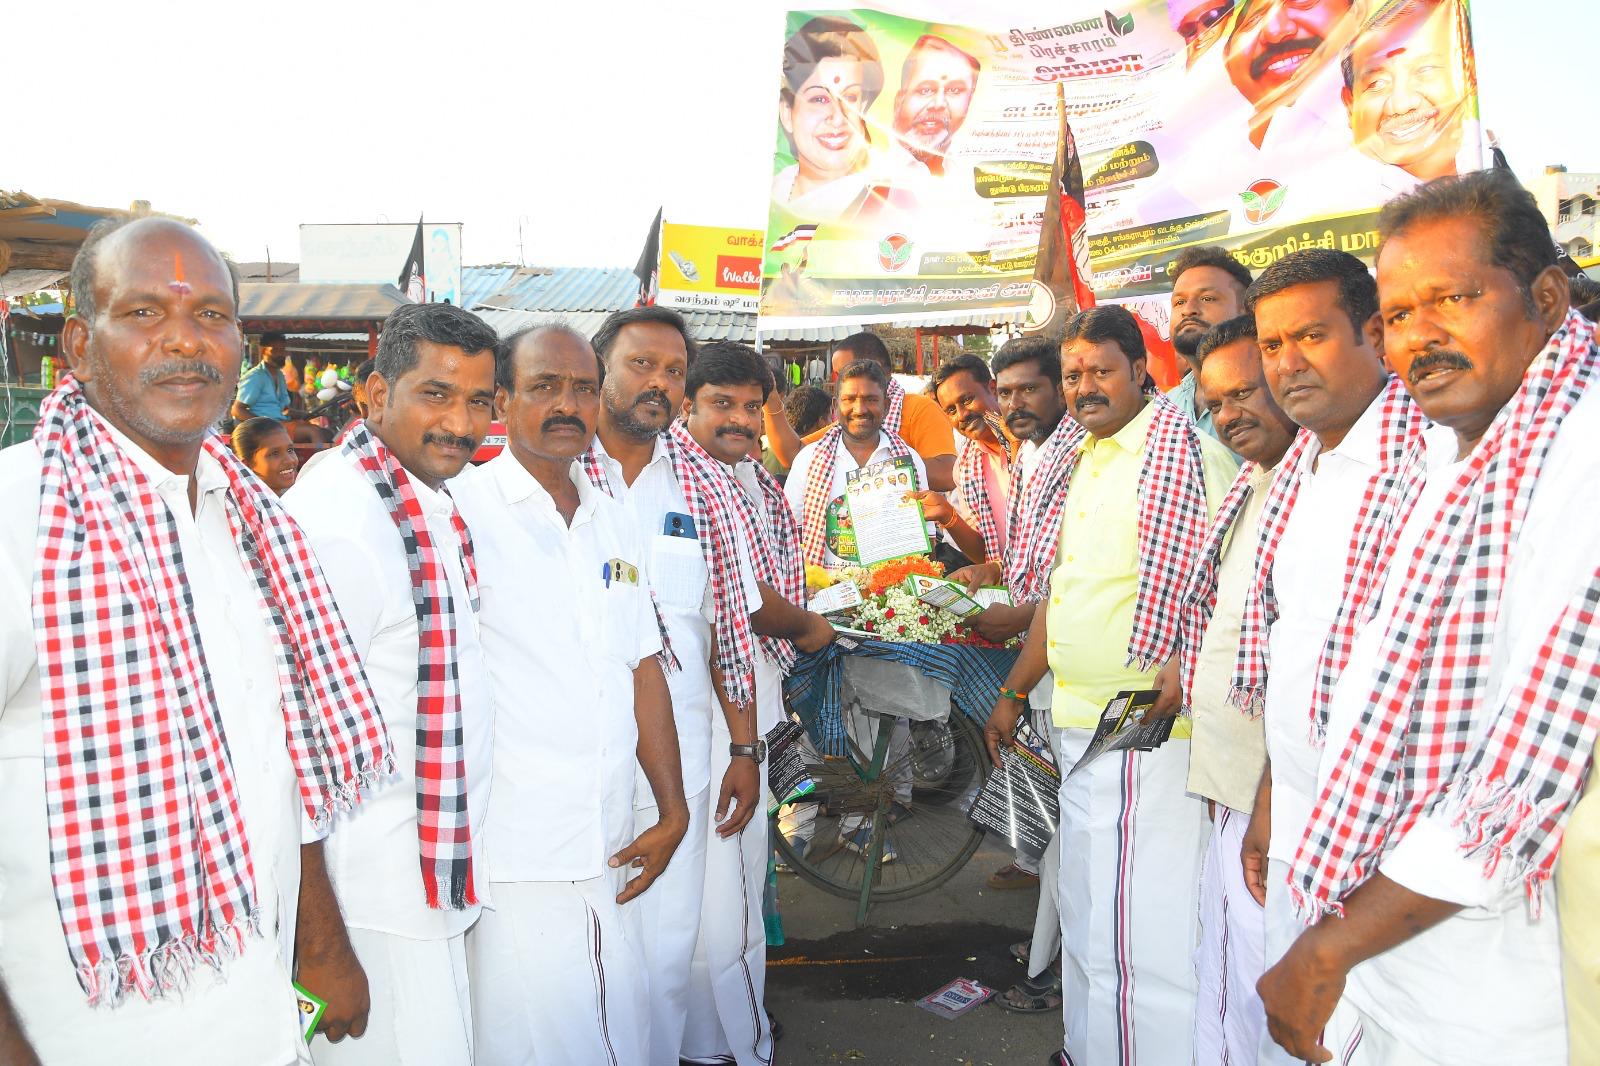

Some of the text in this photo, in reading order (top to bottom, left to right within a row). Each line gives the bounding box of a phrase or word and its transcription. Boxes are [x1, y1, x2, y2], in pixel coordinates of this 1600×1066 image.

[1157, 223, 1184, 236] வடக்கு
[1341, 231, 1381, 251] மா
[675, 294, 720, 306] வசந்தம்
[743, 300, 758, 308] மா
